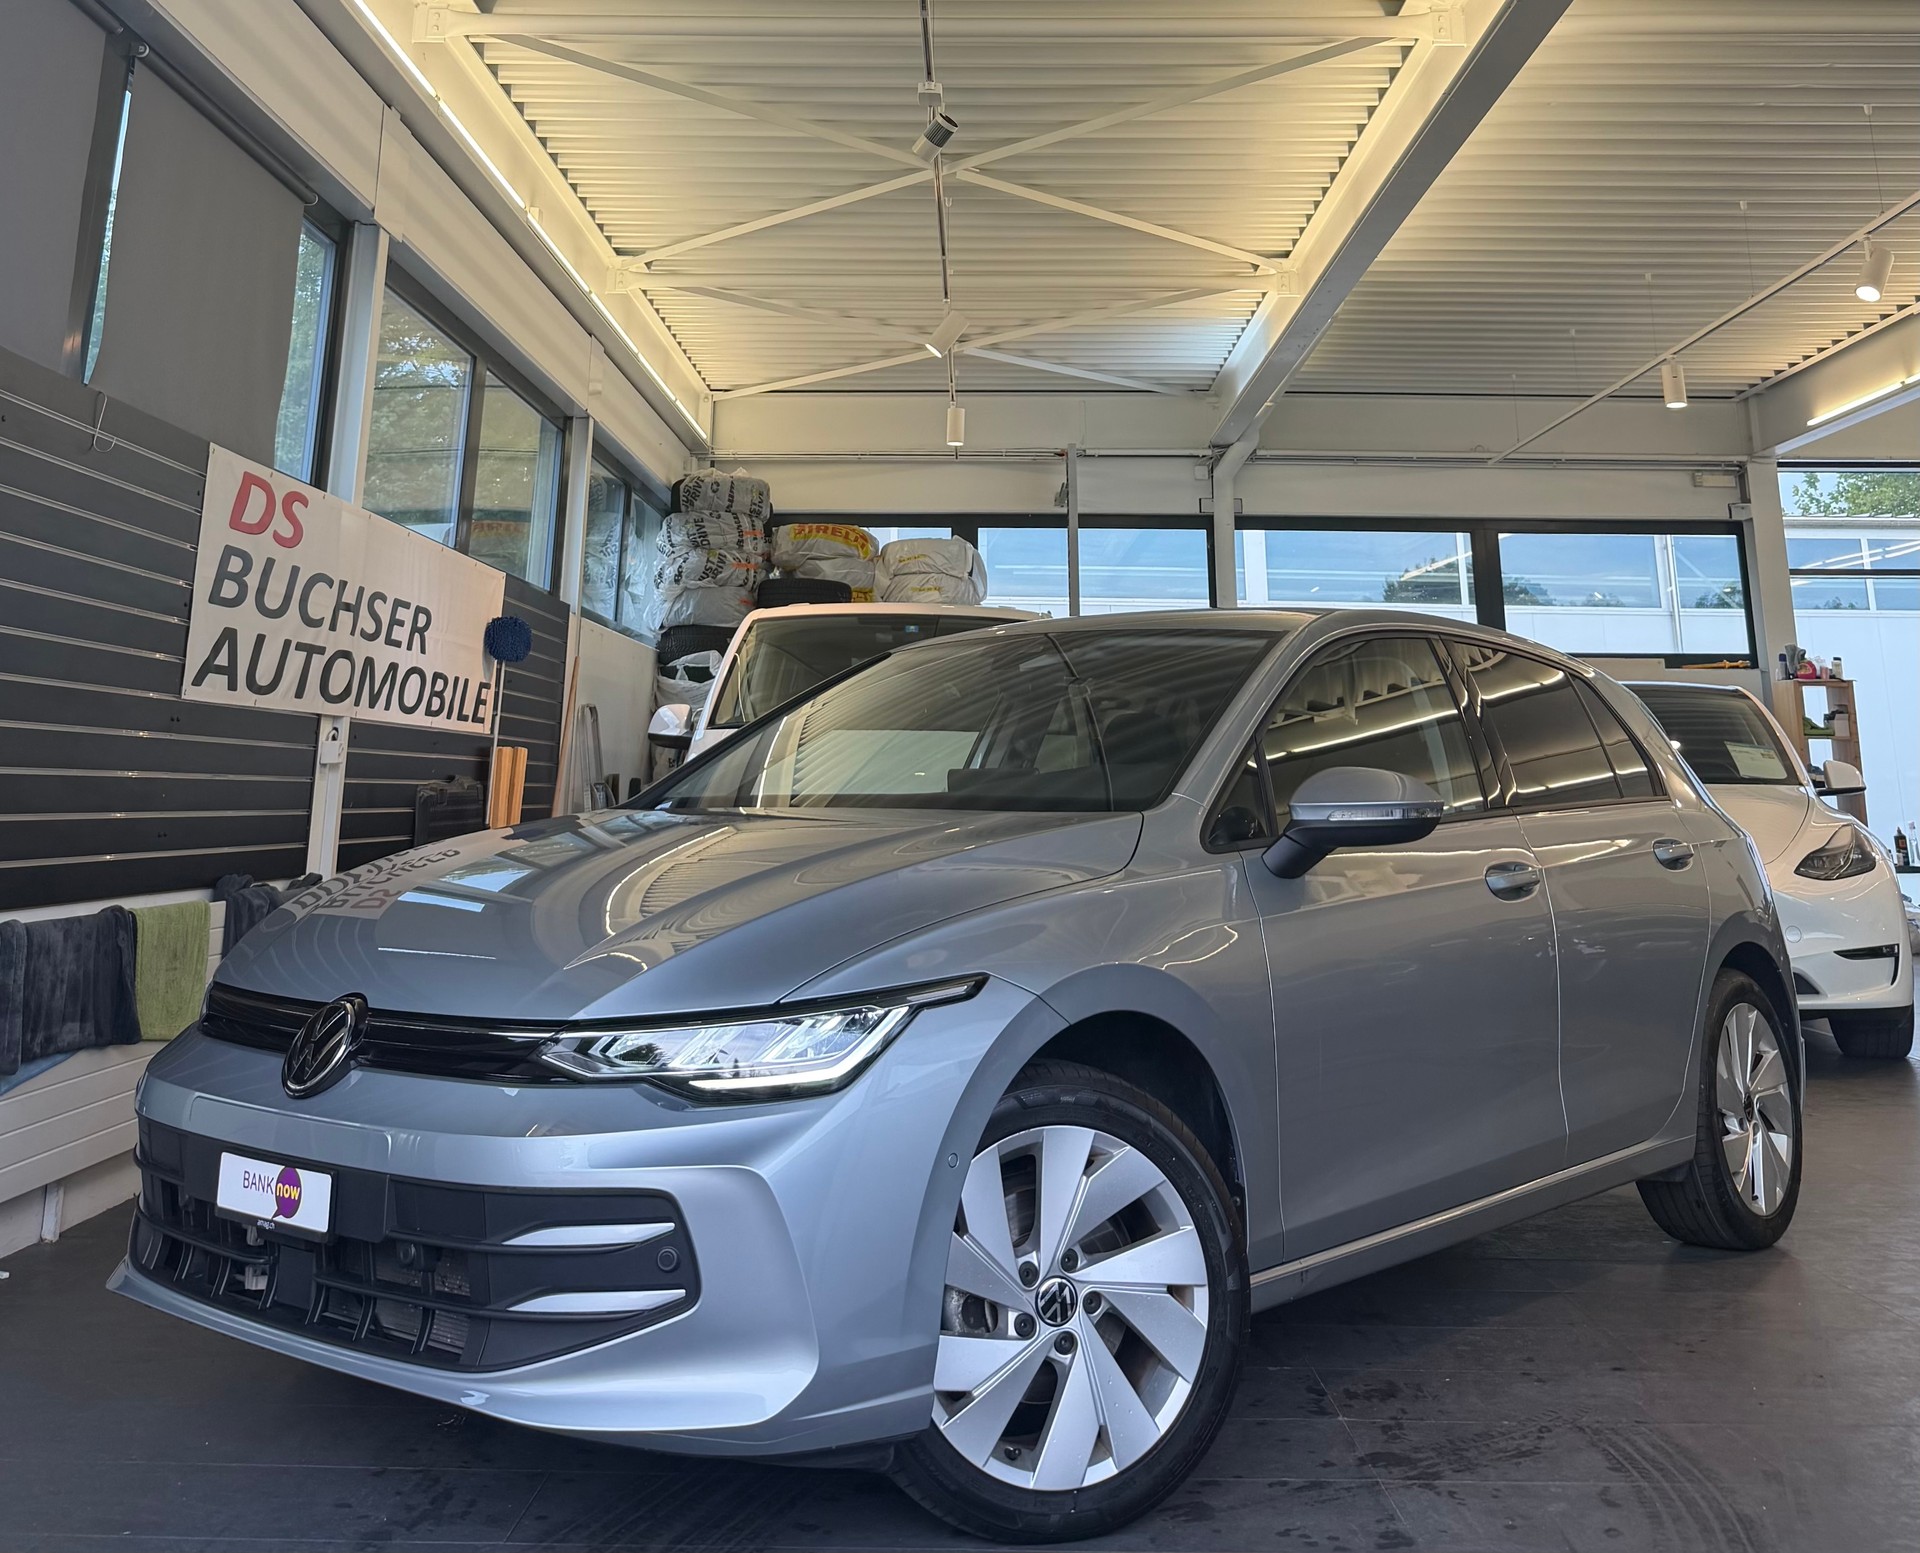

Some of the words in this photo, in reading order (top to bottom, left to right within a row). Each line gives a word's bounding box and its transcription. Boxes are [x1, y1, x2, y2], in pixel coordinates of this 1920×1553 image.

[228, 471, 309, 549] DS
[208, 544, 432, 655] BUCHSER
[191, 626, 491, 724] AUTOMOBILE
[242, 1170, 275, 1195] BANK
[276, 1182, 300, 1201] now
